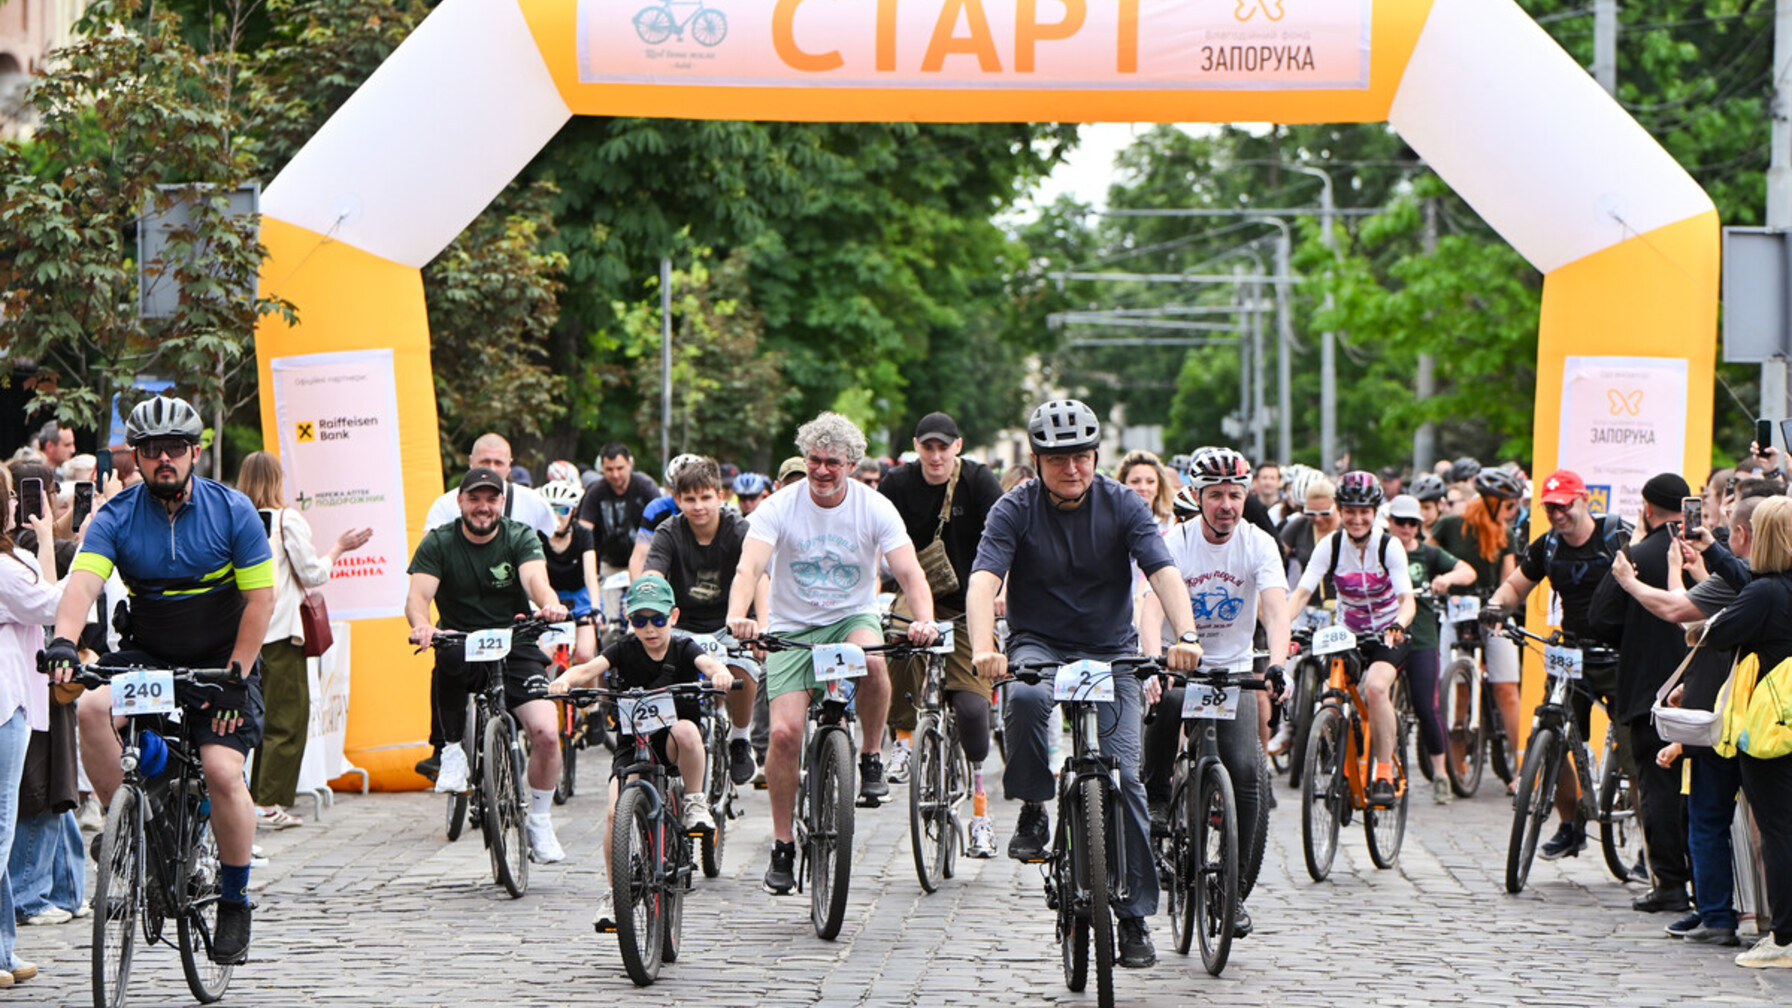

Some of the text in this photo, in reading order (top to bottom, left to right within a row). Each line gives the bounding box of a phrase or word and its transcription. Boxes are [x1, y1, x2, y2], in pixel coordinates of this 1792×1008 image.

[1200, 45, 1315, 72] ЗАПОРУКА
[318, 416, 378, 429] Raiffeisen
[320, 430, 349, 441] Bank
[1590, 427, 1656, 444] ЗАПОРУКА
[333, 556, 386, 567] ИЦЬКА
[478, 637, 503, 650] 121
[700, 641, 718, 652] 30
[835, 653, 845, 666] 1
[1080, 671, 1091, 685] 2
[124, 682, 162, 699] 240
[636, 705, 659, 720] 29
